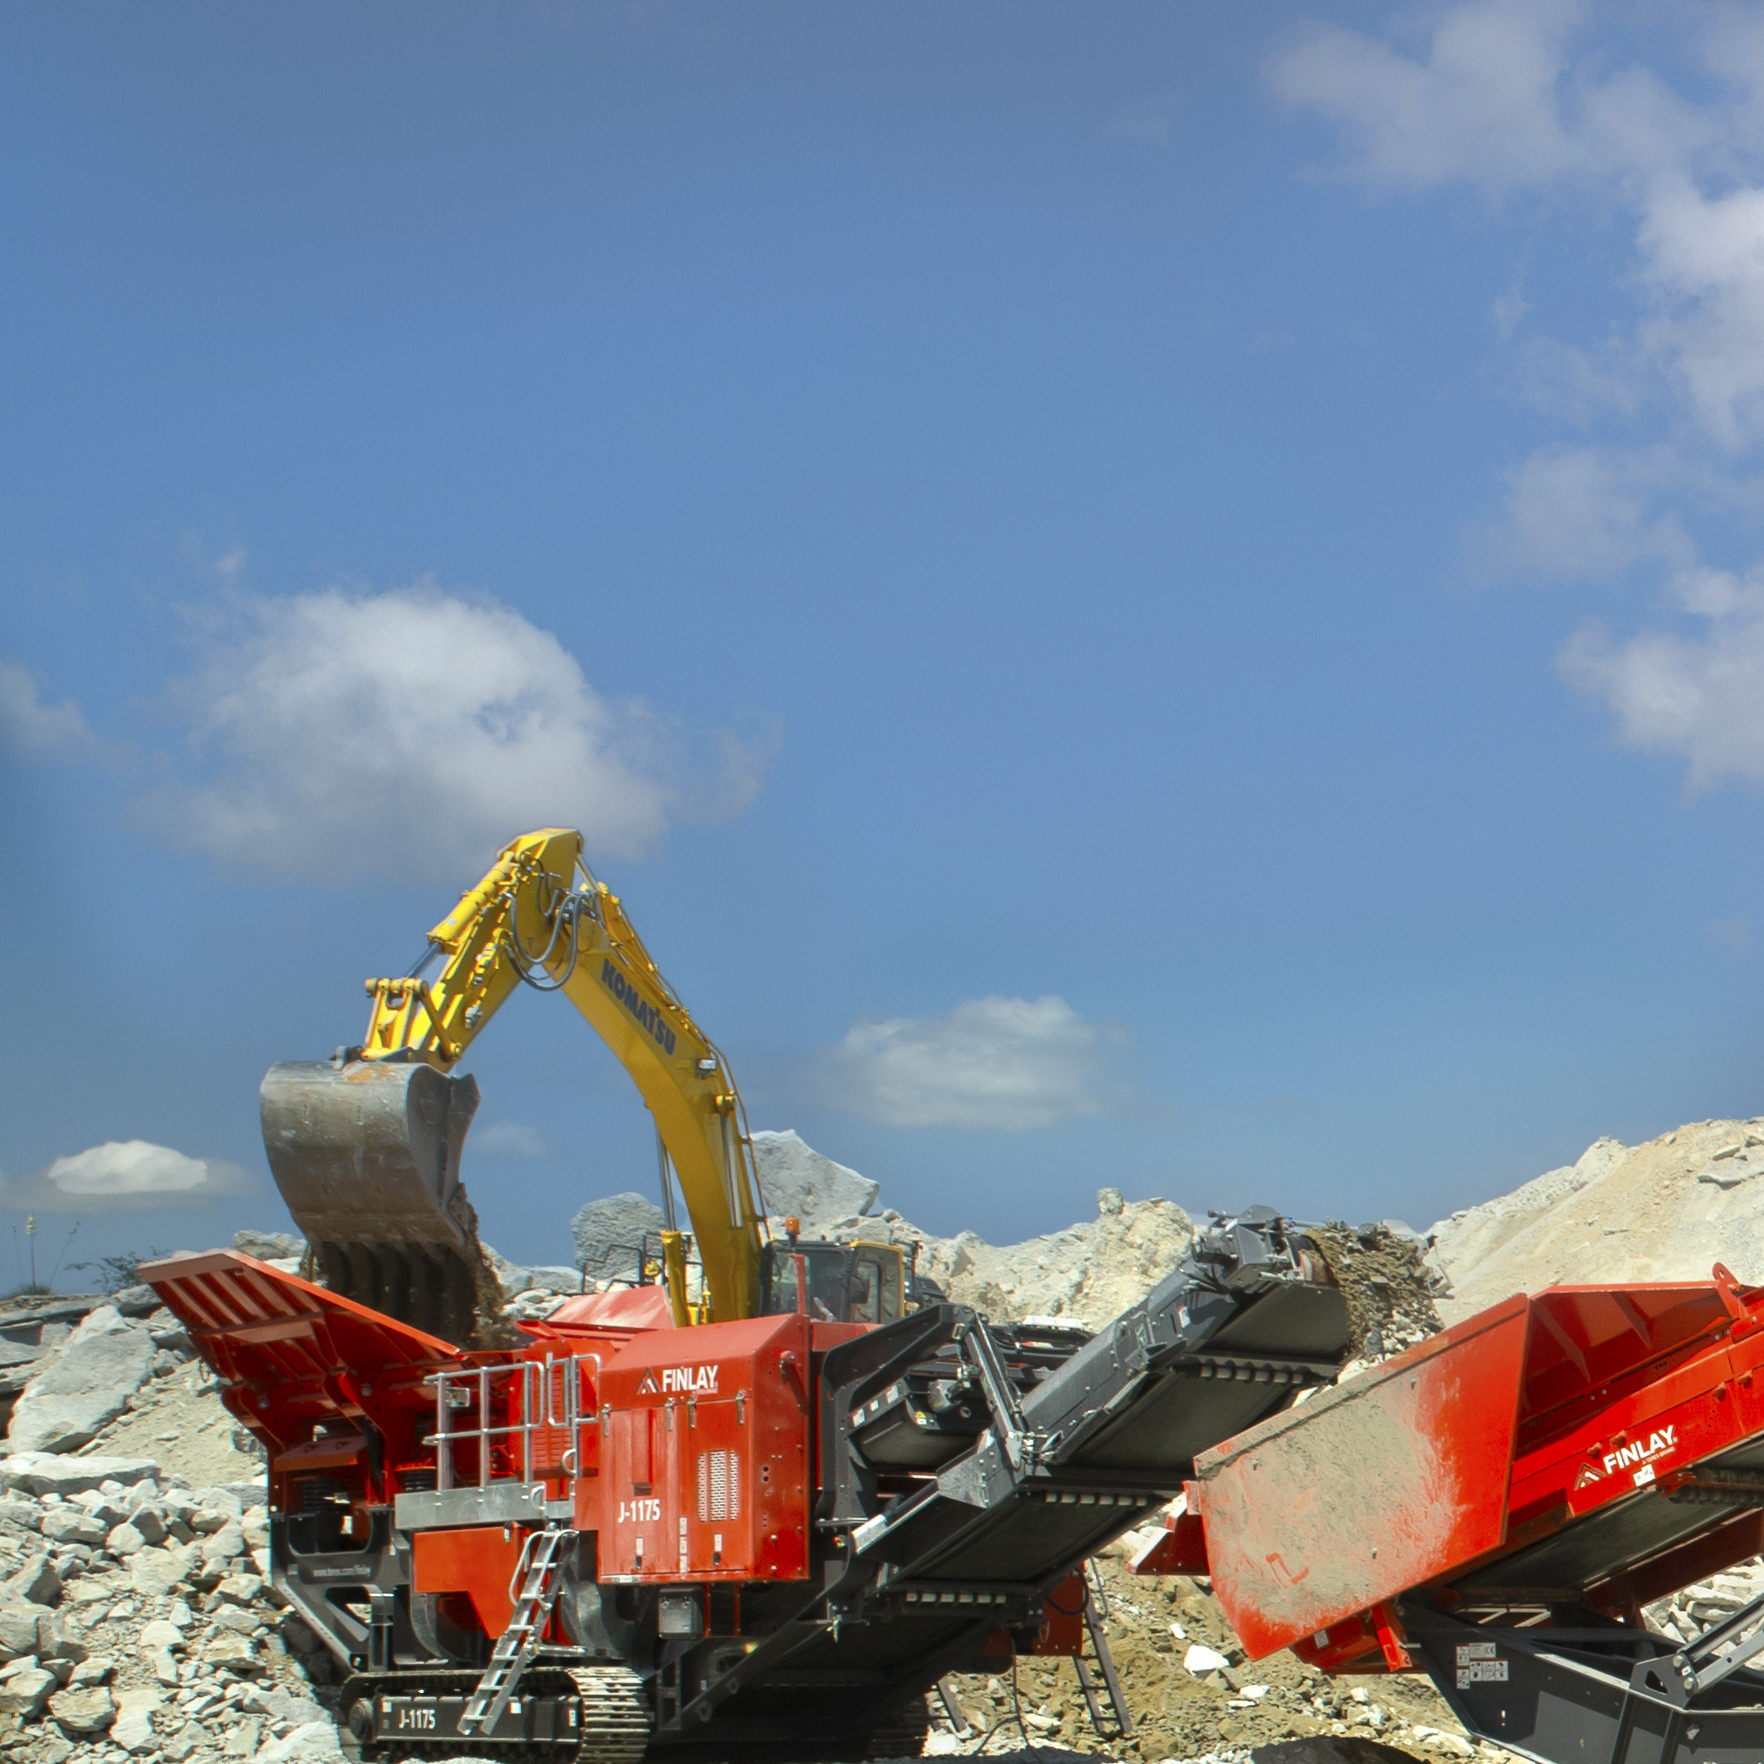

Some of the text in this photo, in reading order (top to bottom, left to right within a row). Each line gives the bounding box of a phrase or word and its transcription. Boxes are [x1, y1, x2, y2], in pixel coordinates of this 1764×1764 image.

[601, 957, 677, 1057] KOMATSU
[662, 1364, 719, 1393] FINLAY
[1602, 1424, 1675, 1475] FINLAY
[618, 1498, 661, 1524] J-1175
[398, 1708, 437, 1729] J-1175
